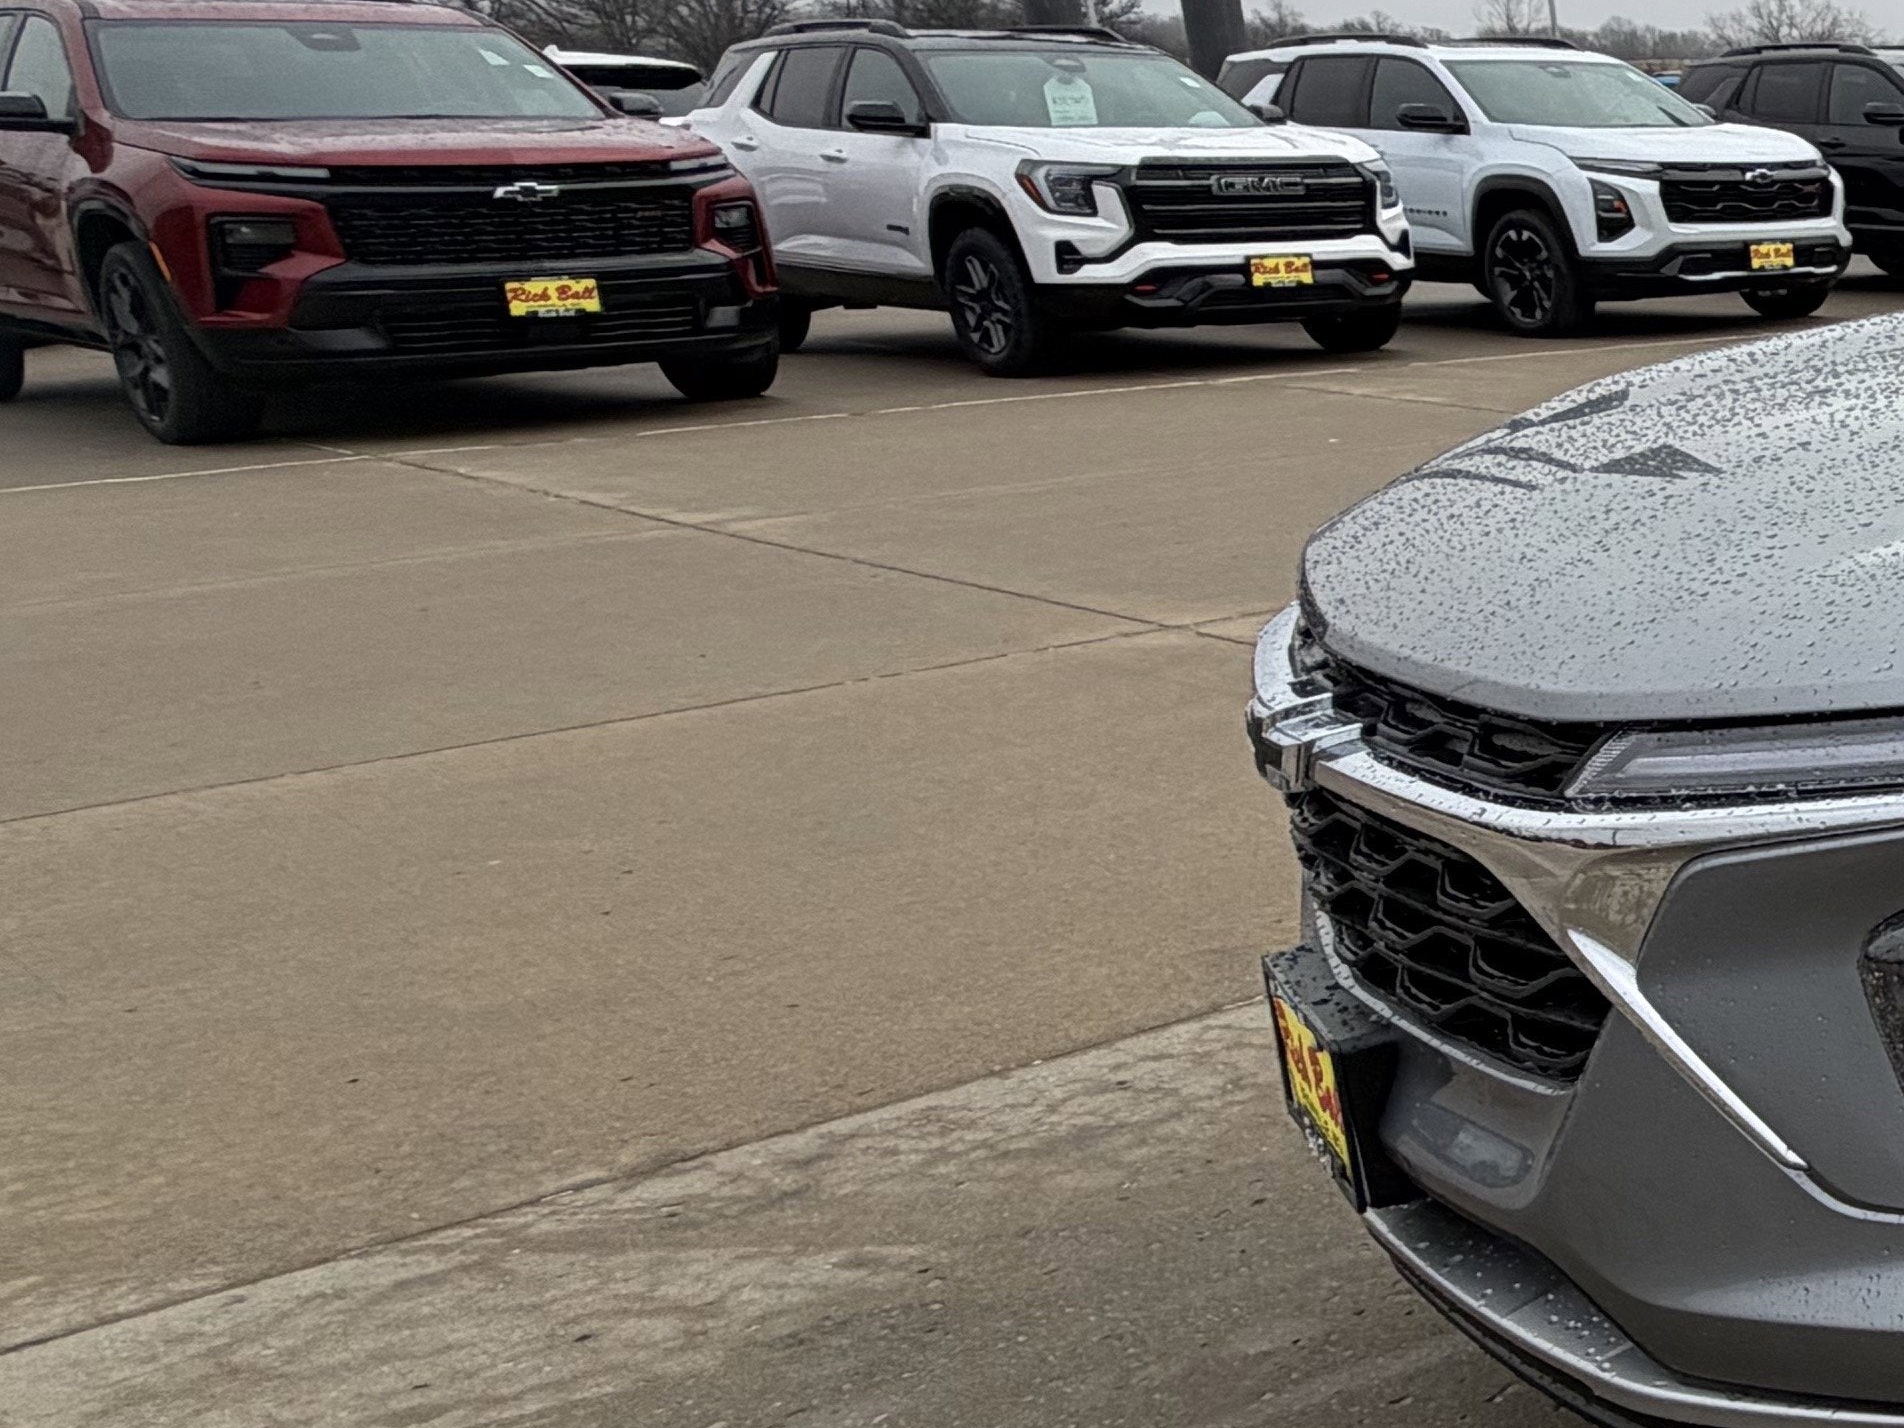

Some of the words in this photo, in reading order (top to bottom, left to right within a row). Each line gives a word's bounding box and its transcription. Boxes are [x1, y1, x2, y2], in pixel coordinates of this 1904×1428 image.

[1211, 174, 1305, 195] GMC
[507, 286, 552, 304] Rick
[555, 283, 597, 301] Ball
